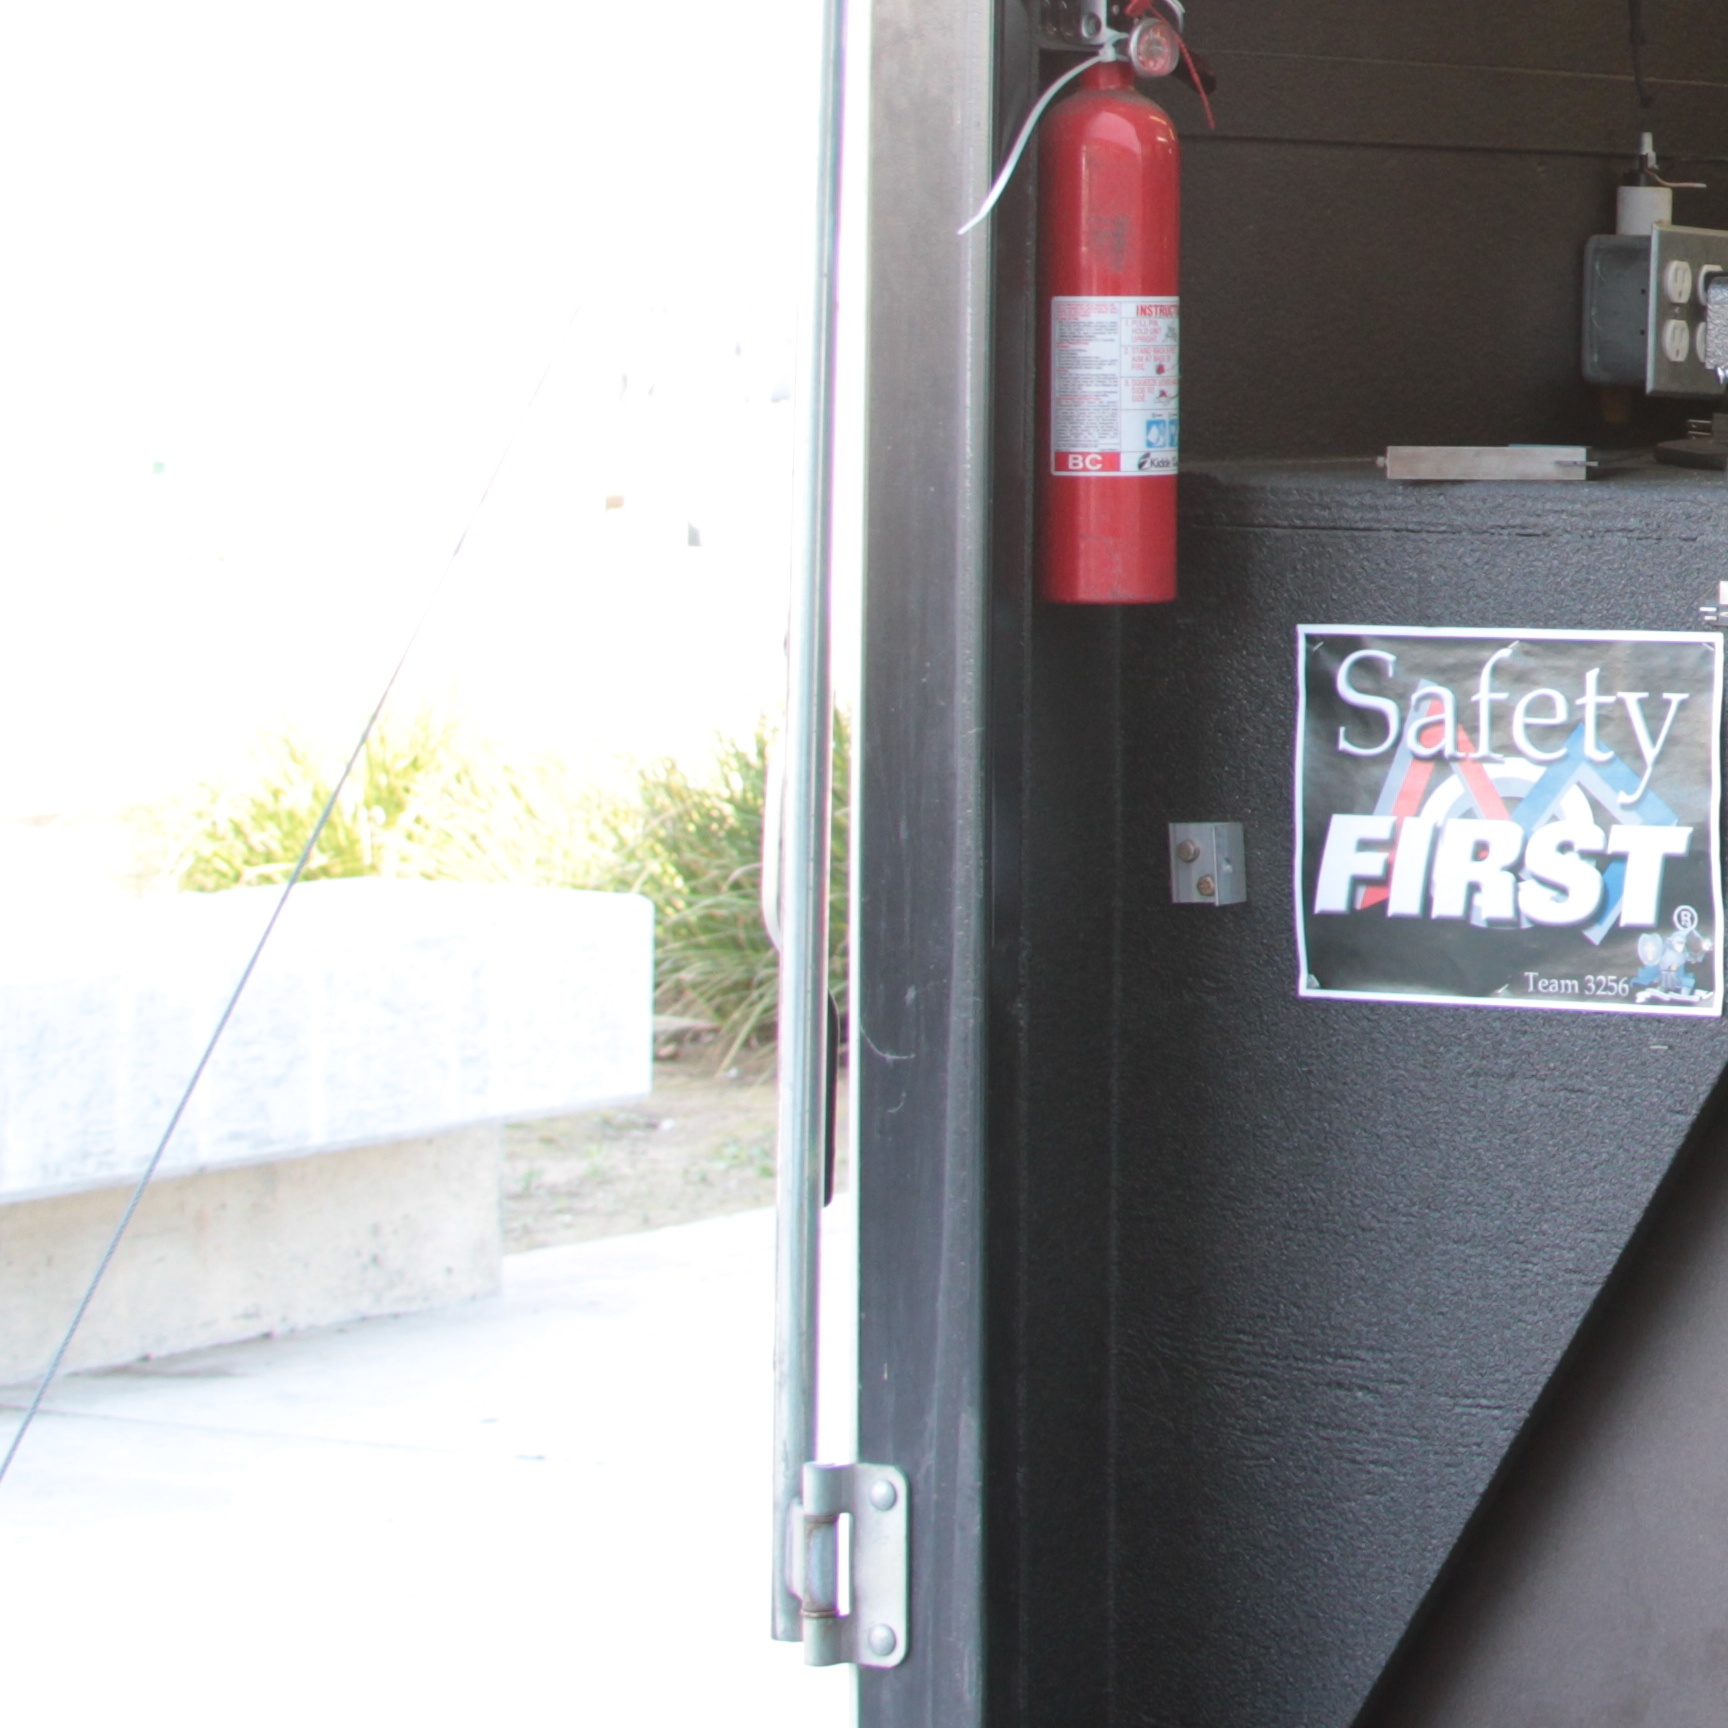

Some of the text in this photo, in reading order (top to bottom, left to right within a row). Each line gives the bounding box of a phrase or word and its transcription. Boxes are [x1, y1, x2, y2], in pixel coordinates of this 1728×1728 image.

[1068, 454, 1104, 470] BC
[1336, 646, 1690, 804] Safety
[1313, 813, 1694, 928] FIRST
[1524, 971, 1630, 997] Team 3256
